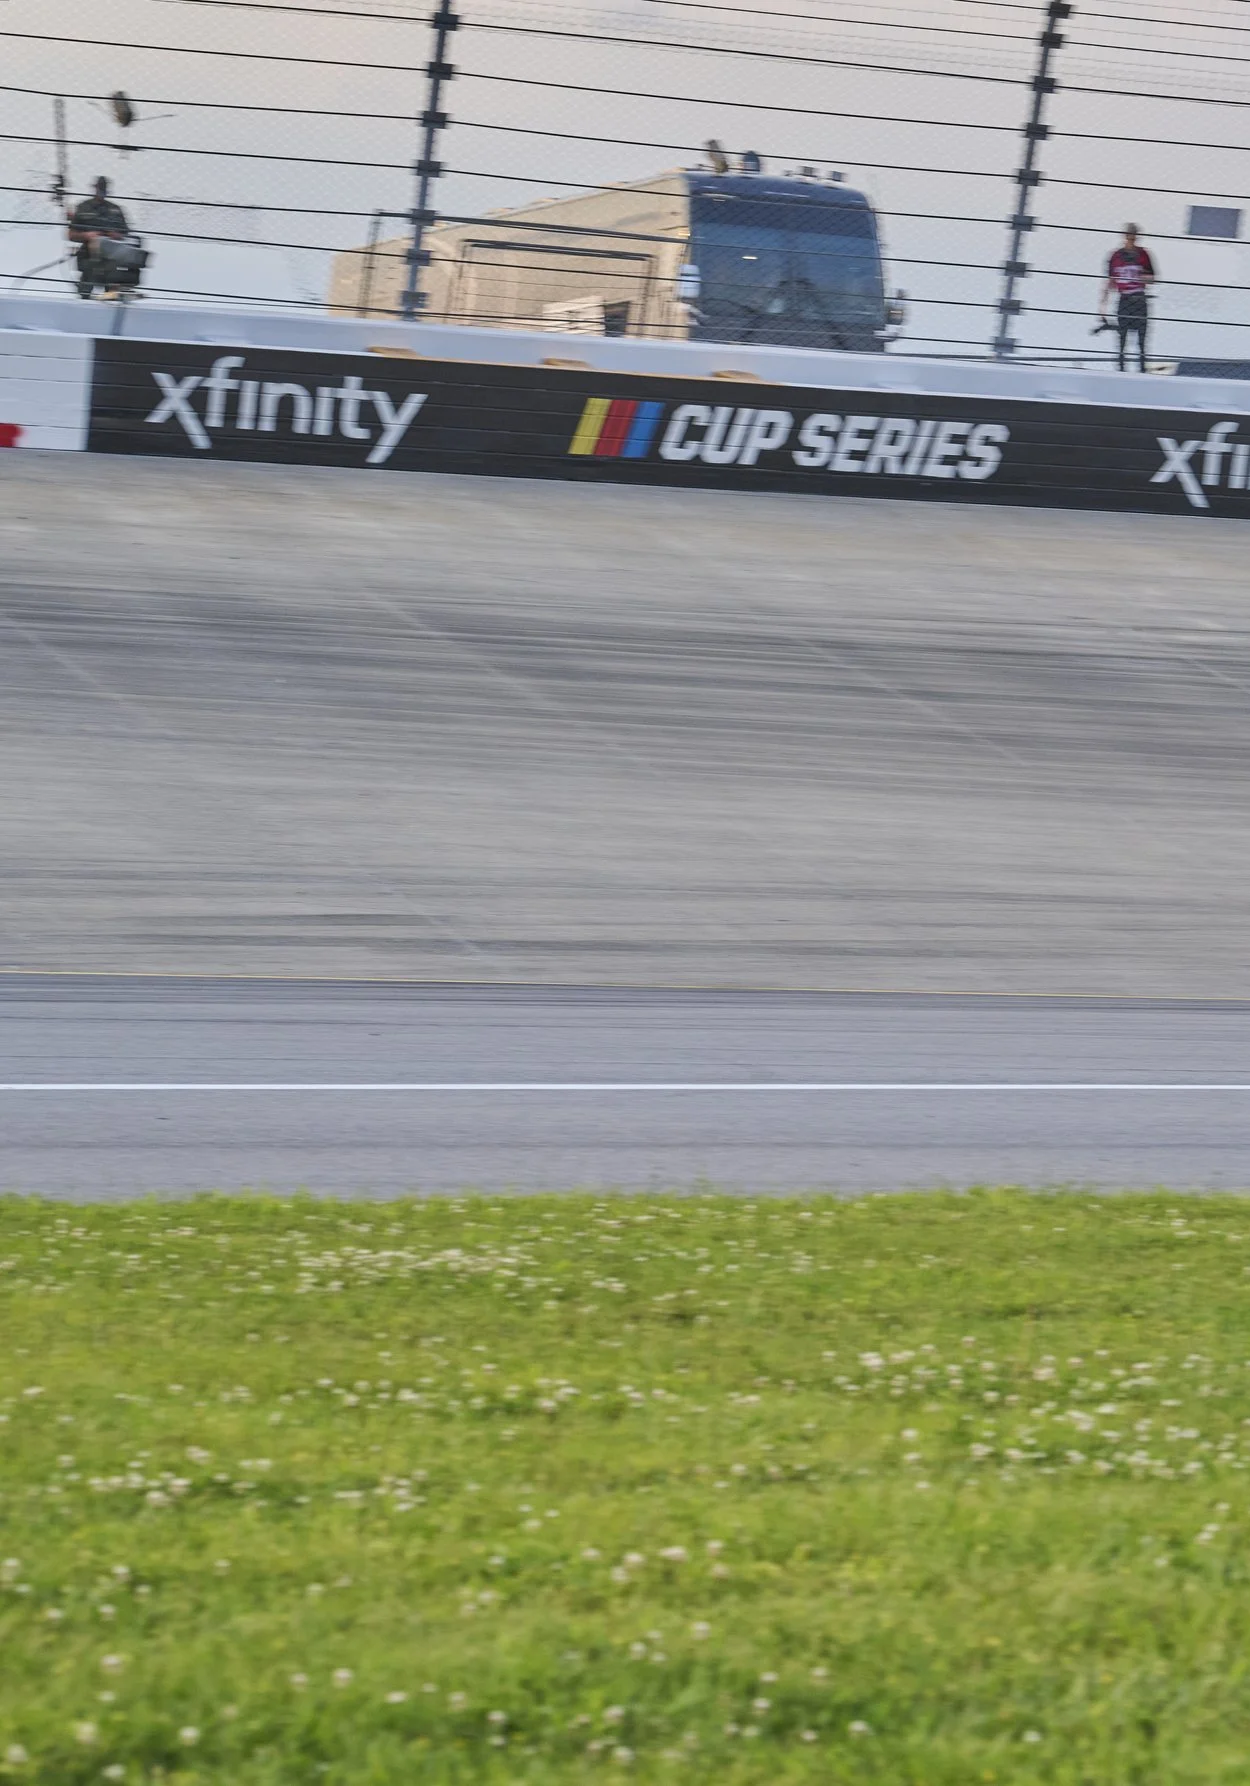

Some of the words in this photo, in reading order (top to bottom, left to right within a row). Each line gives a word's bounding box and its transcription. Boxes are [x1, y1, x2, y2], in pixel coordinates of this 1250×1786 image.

[145, 356, 428, 463] xfinity
[659, 404, 794, 465] CUP
[792, 414, 1010, 480] SERIES
